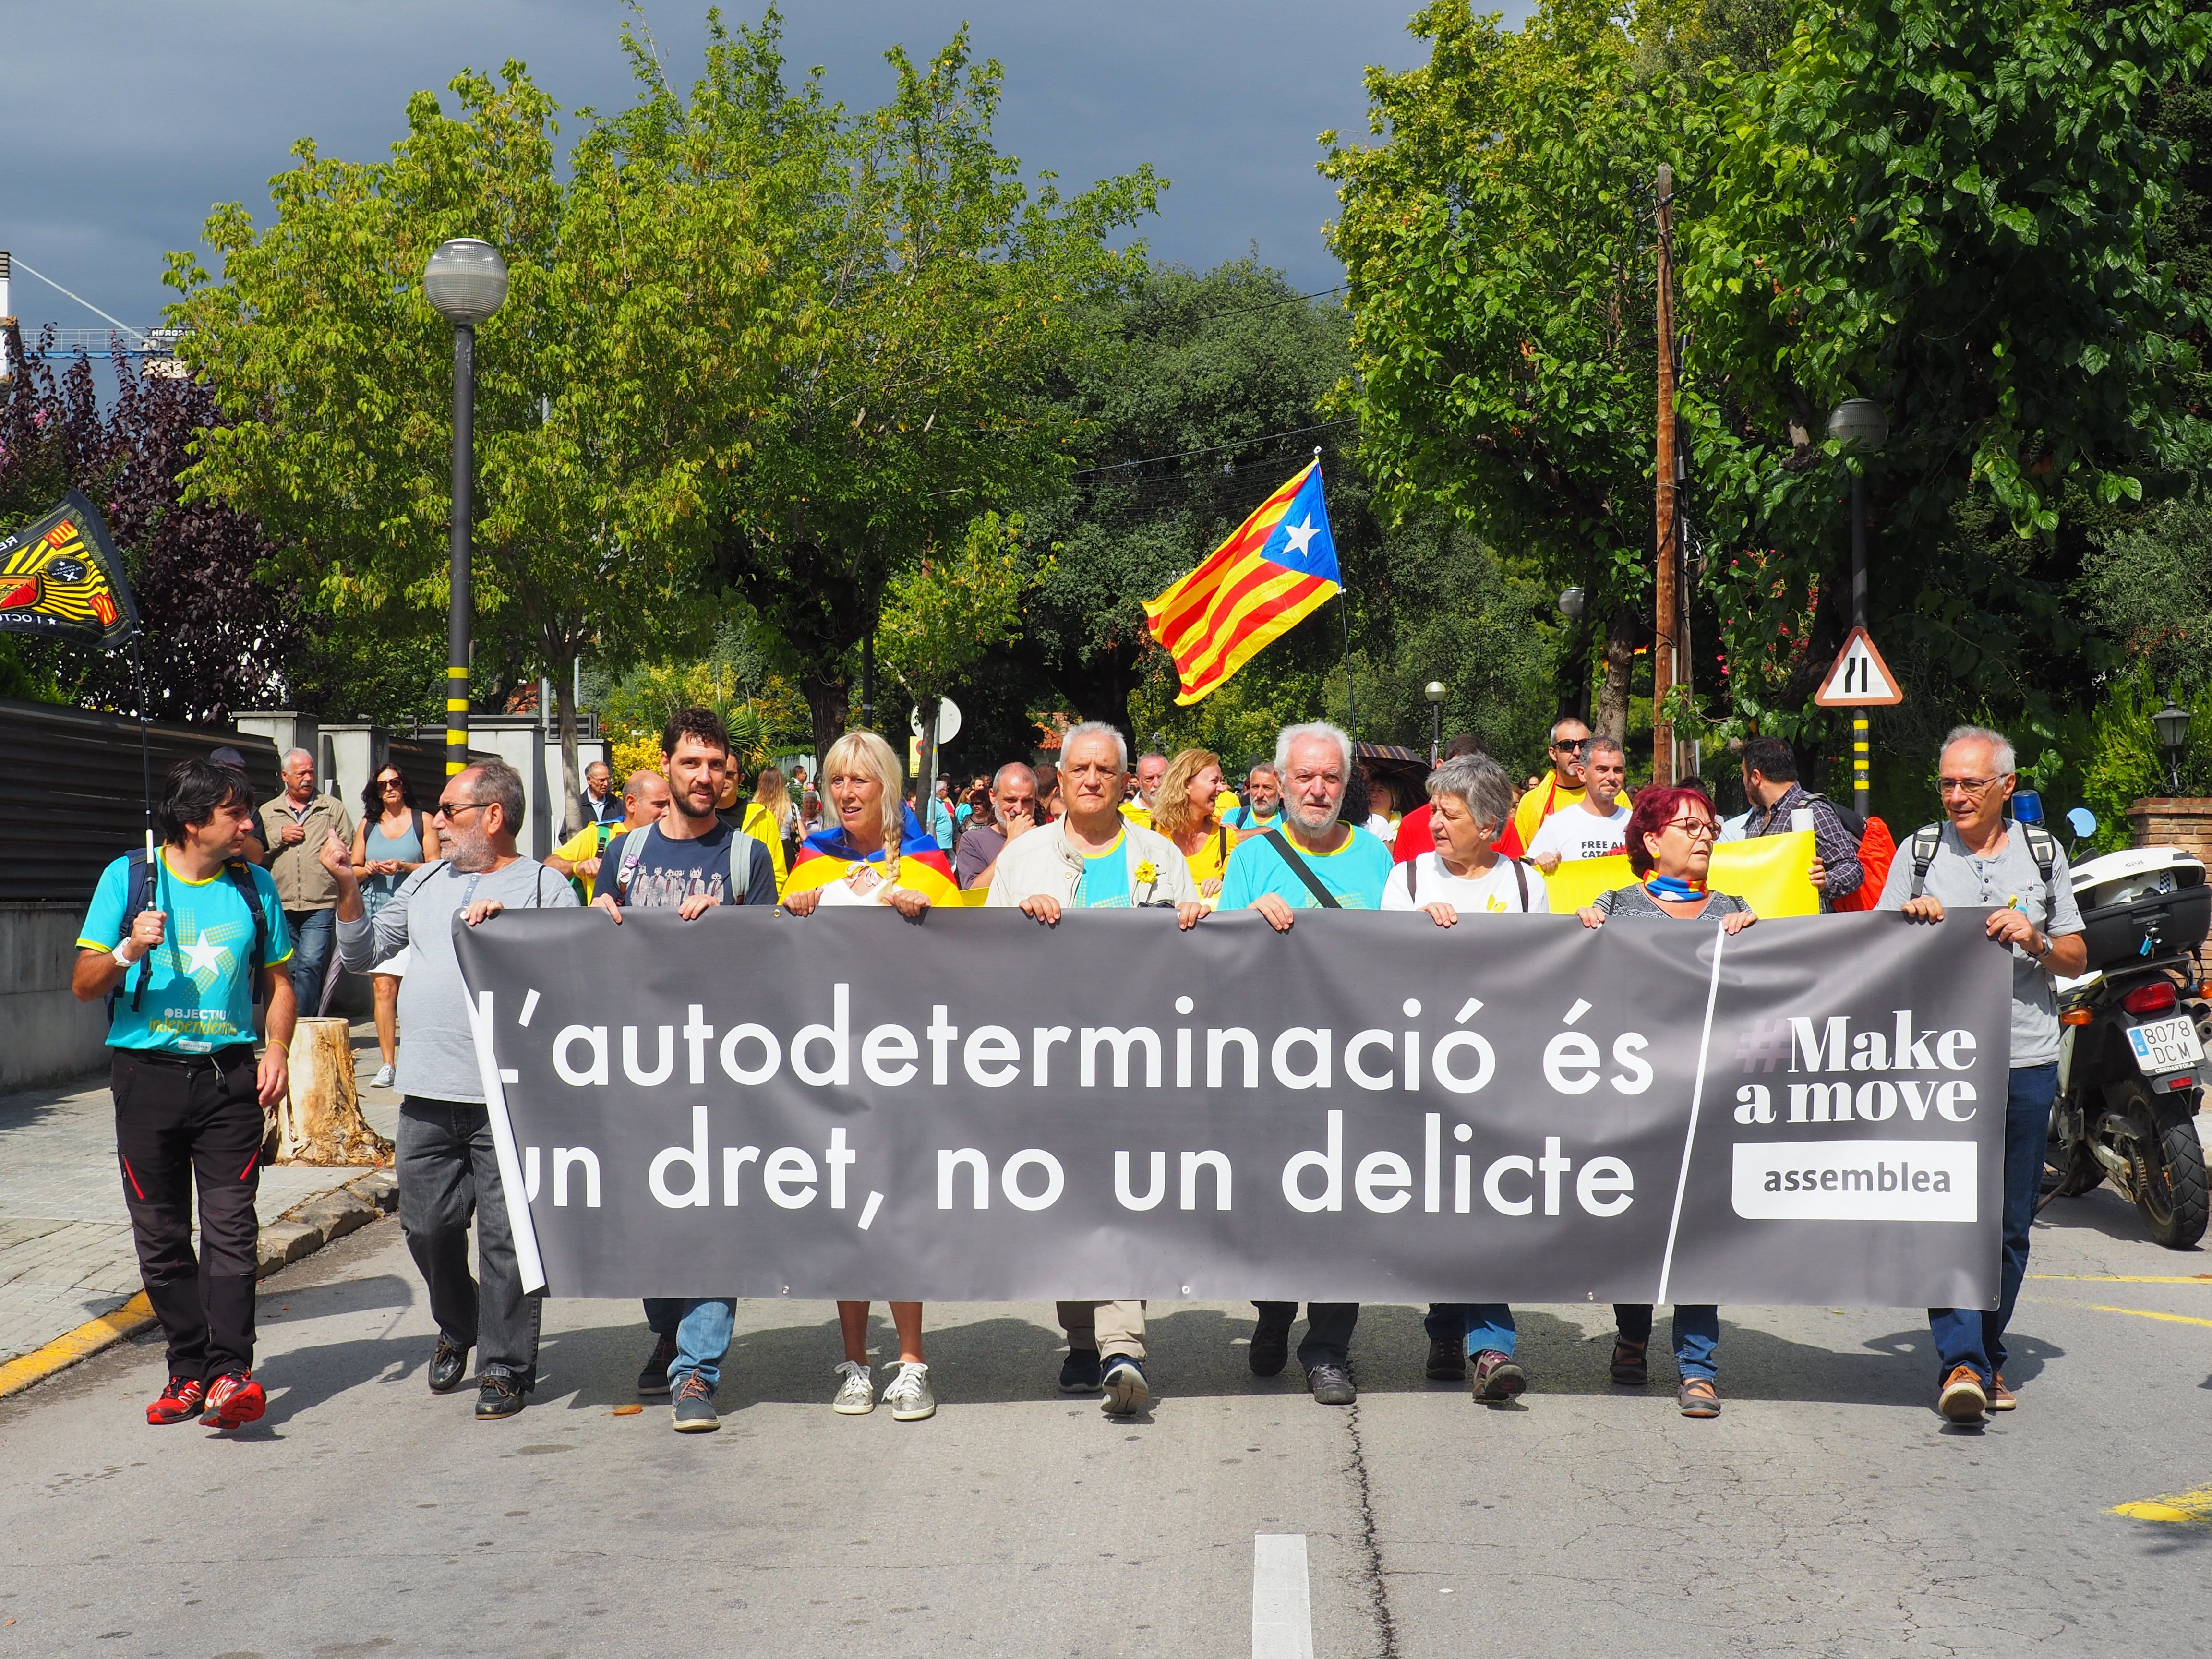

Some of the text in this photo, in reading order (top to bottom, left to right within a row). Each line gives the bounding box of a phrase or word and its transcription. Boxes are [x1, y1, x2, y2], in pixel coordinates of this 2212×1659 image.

[1581, 841, 1608, 849] FREE
[164, 1008, 227, 1021] OBJECTIU
[2144, 1021, 2190, 1044] 8078
[1543, 998, 1654, 1095] és
[2153, 1041, 2191, 1064] DCM
[2155, 1061, 2195, 1073] CERDANYOLA
[1734, 1080, 1977, 1124] a move
[649, 1106, 884, 1230] dret,
[938, 1148, 1065, 1211] no
[1114, 1150, 1232, 1211] un
[1282, 1109, 1634, 1217] delicte
[1764, 1162, 1951, 1193] assemblea
